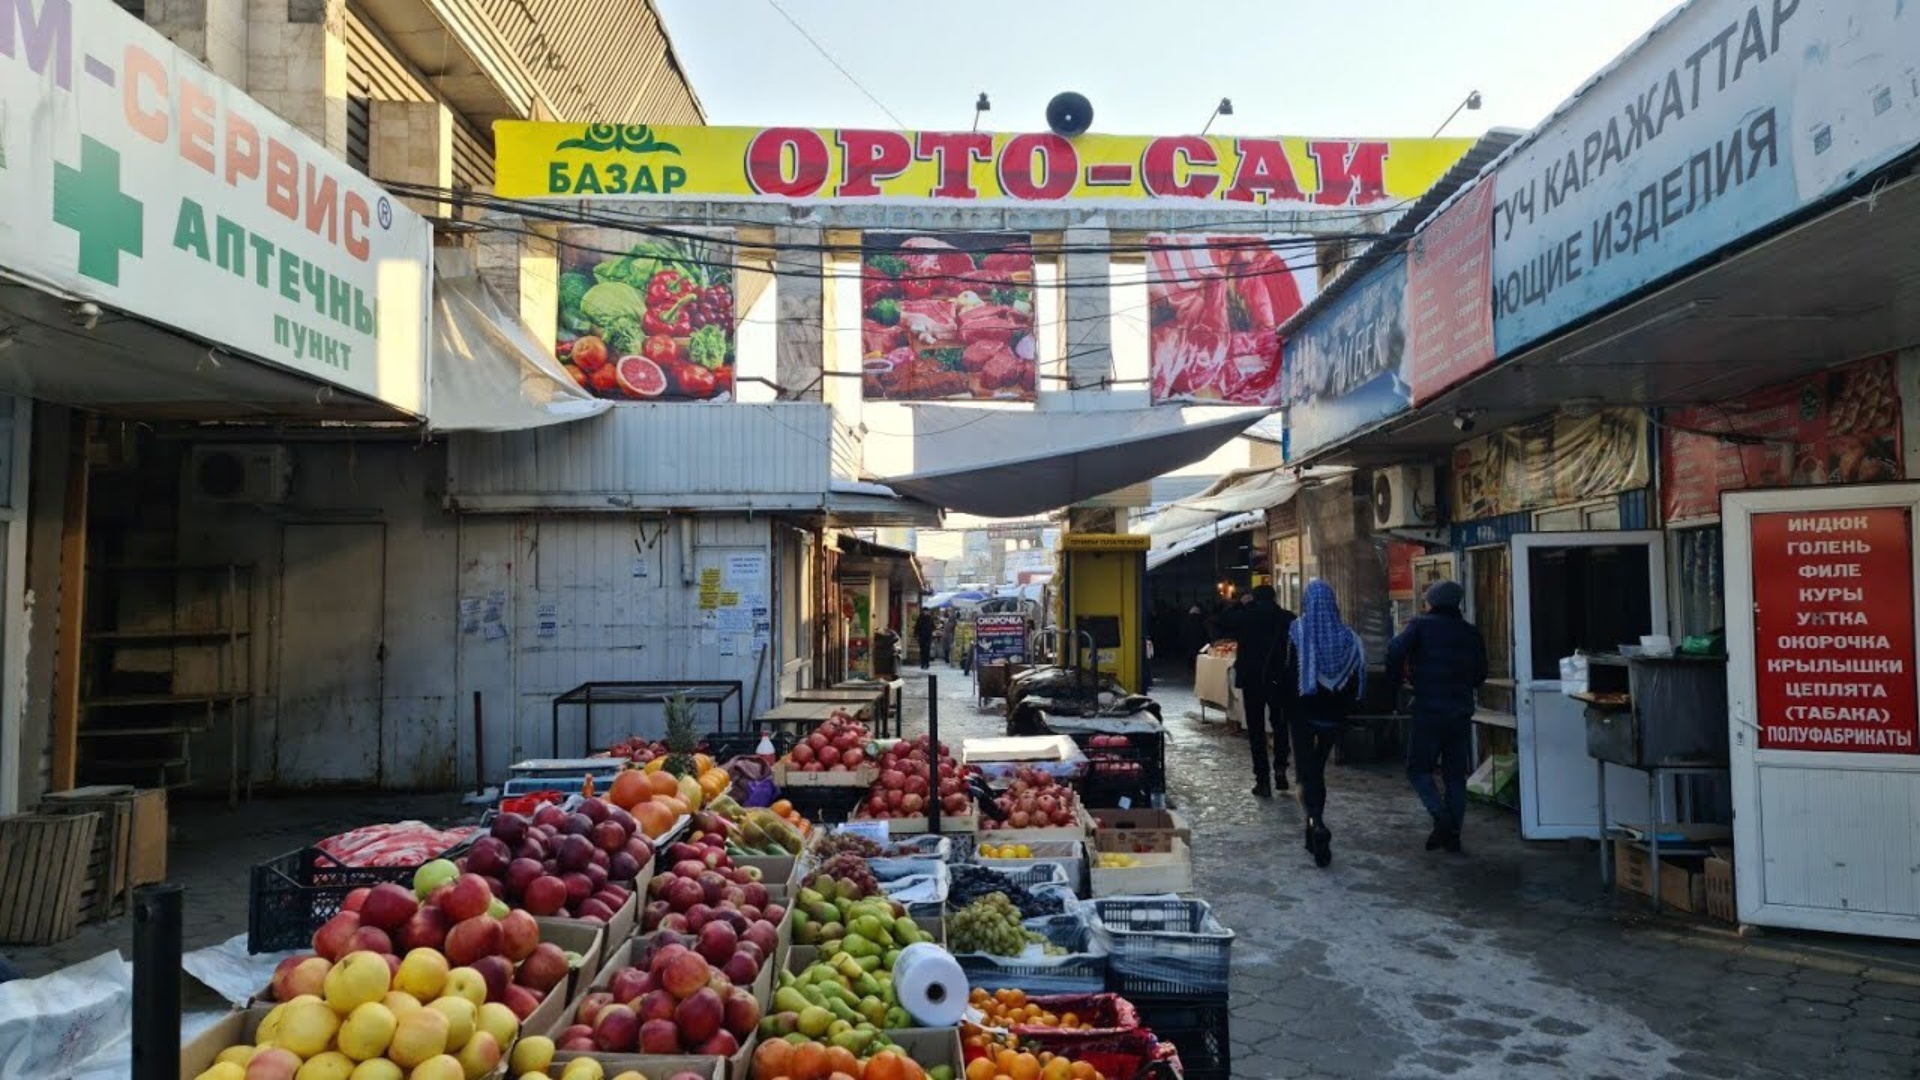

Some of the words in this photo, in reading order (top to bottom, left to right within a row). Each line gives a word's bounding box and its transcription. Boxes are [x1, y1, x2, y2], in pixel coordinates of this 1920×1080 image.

[1543, 0, 1799, 214] КАРАЖАТТАР
[549, 162, 687, 194] БАЗАР
[1592, 107, 1778, 267] ИЗДЕЛИЯ
[172, 196, 379, 340] АПТЕЧНЫ
[1788, 516, 1868, 533] ИНДЮК
[1787, 540, 1871, 555] ГОЛЕНЬ
[1798, 563, 1862, 578] ФИЛЕ
[1799, 587, 1863, 602] КУРЫ
[977, 616, 1023, 625] ОКОРОЧКА
[1778, 635, 1891, 649] ОКОРОЧКА
[1767, 659, 1903, 673] КРЫЛЫШКИ
[1786, 683, 1887, 698] ЦЕПЛЯТА
[1785, 705, 1891, 723] (ТАБАКА)
[1767, 725, 1912, 746] ПОЛУФАБРИКАТЫ
